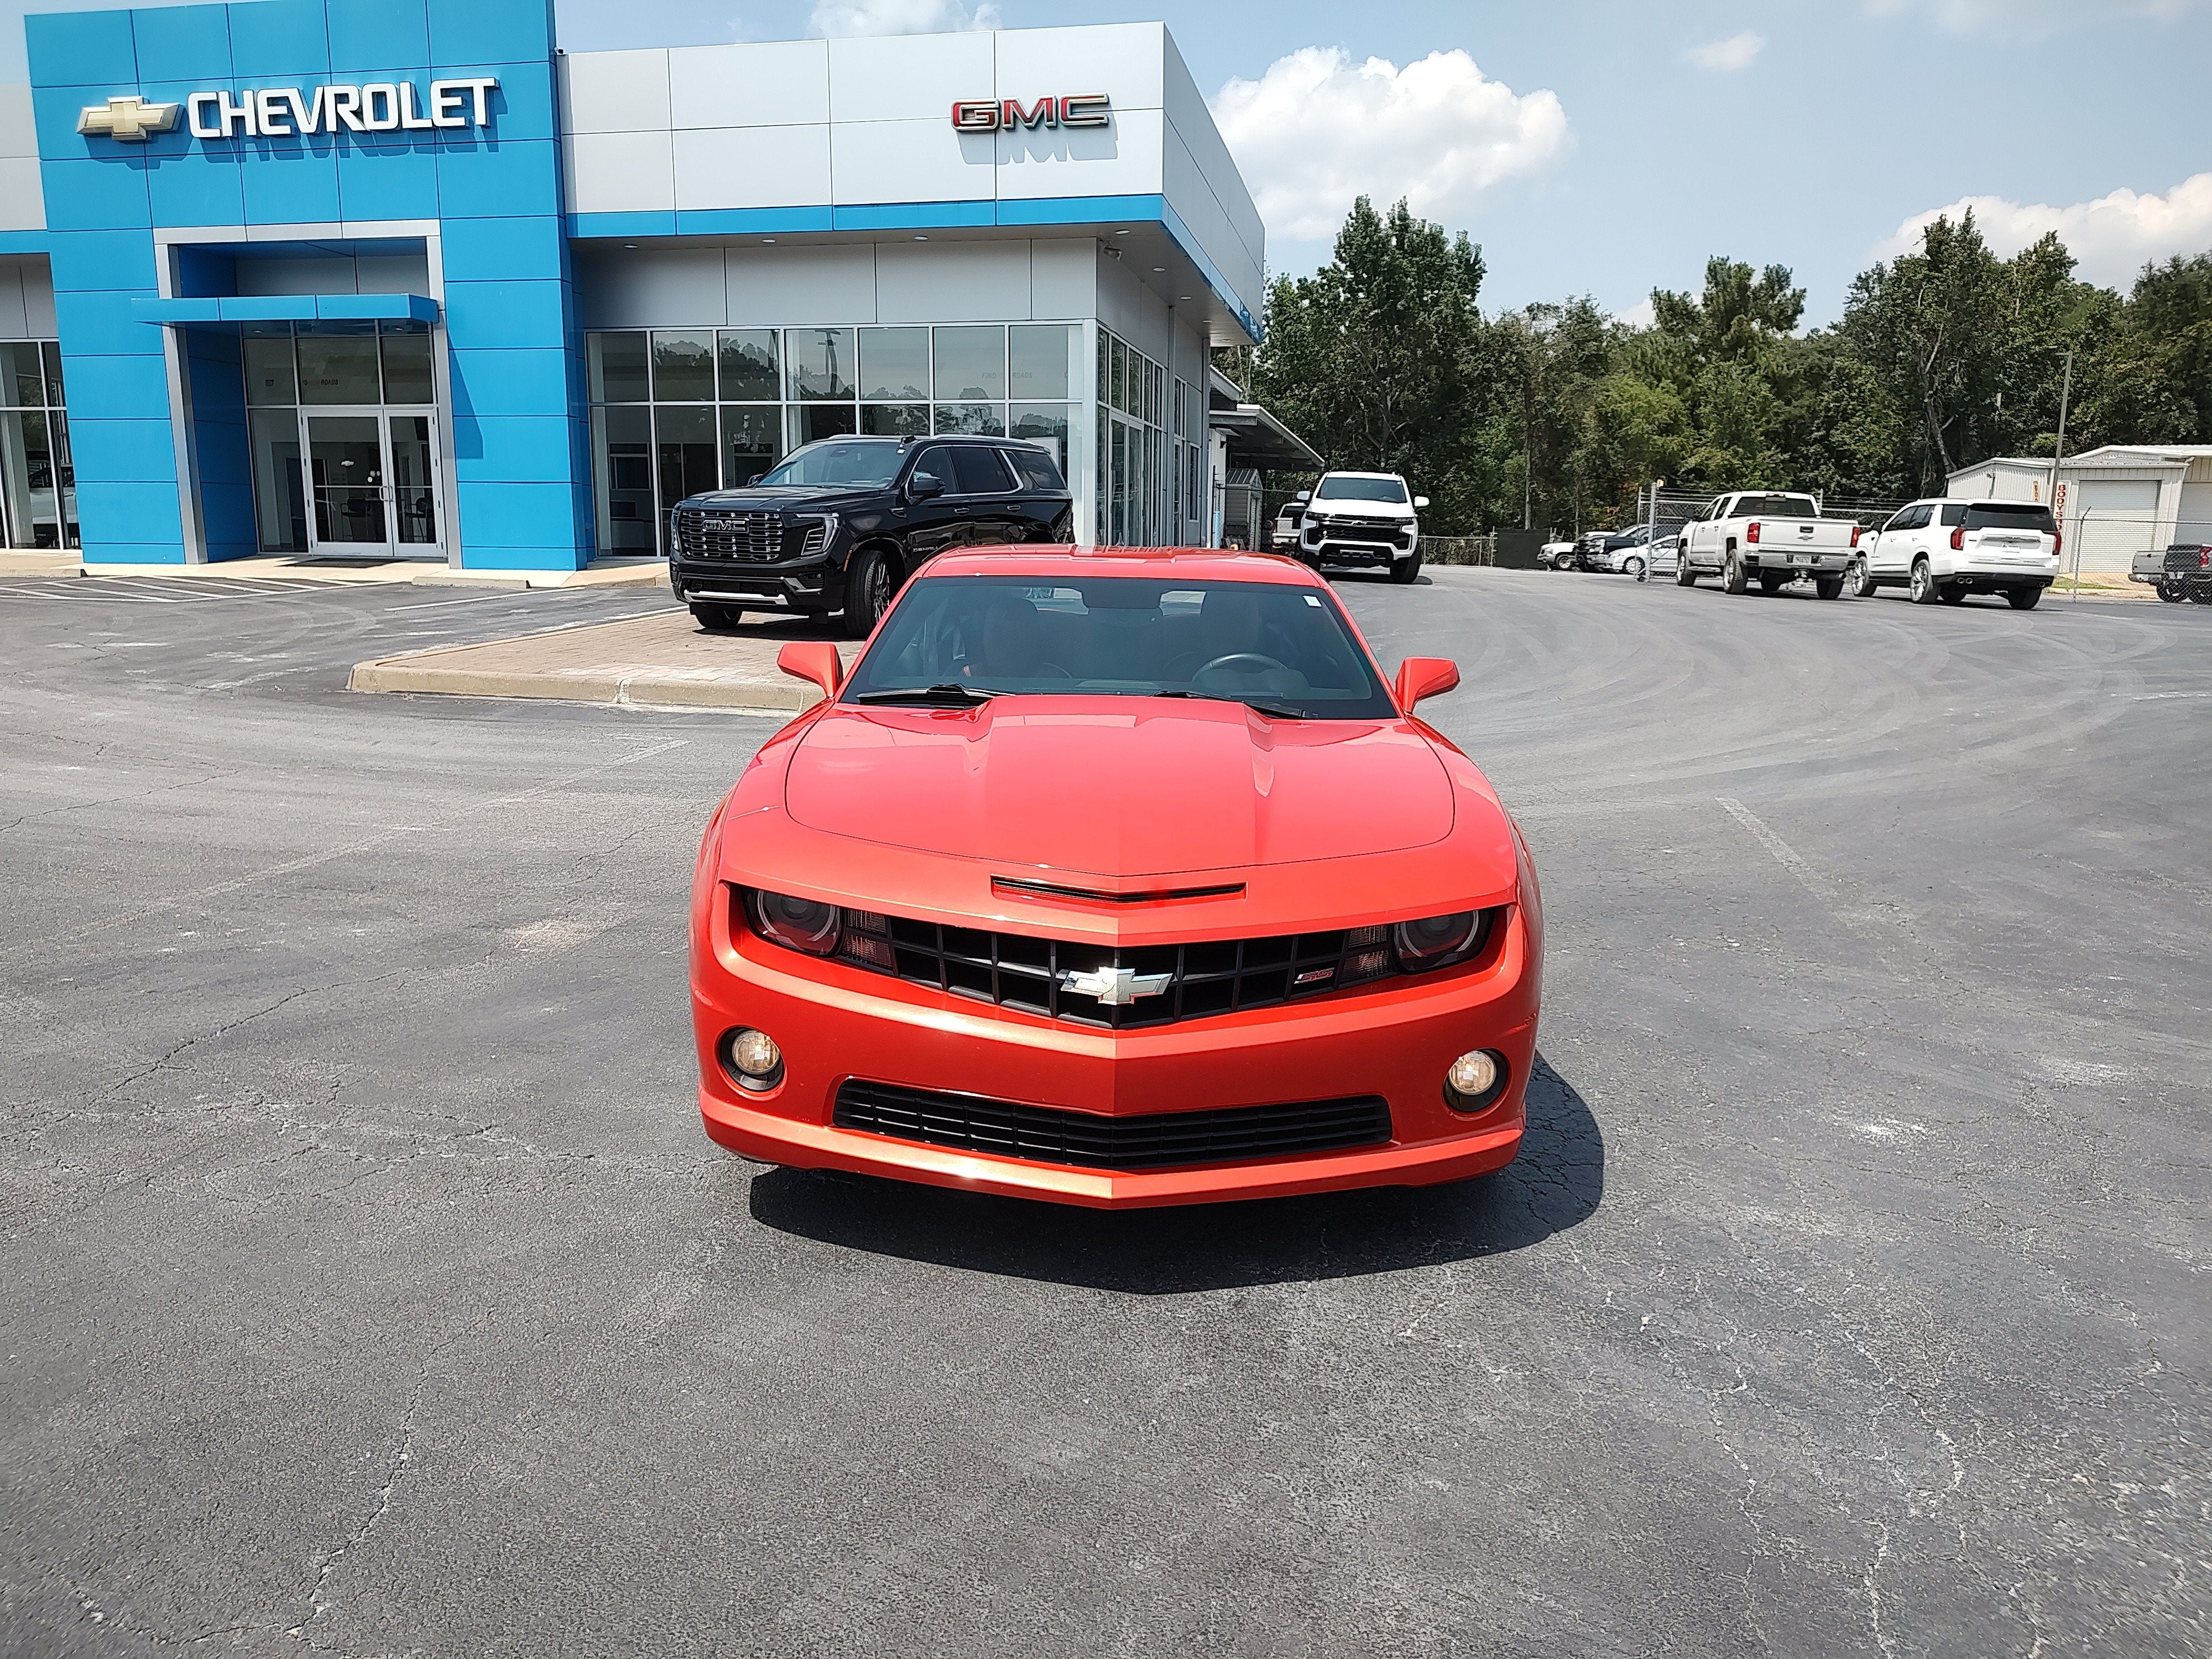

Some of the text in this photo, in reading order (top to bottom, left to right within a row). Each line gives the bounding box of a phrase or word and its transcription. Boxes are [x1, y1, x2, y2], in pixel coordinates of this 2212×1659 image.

[187, 77, 498, 138] CHEVROLET
[951, 92, 1109, 132] GMC
[703, 520, 745, 531] GMC
[1294, 967, 1335, 984] SS
